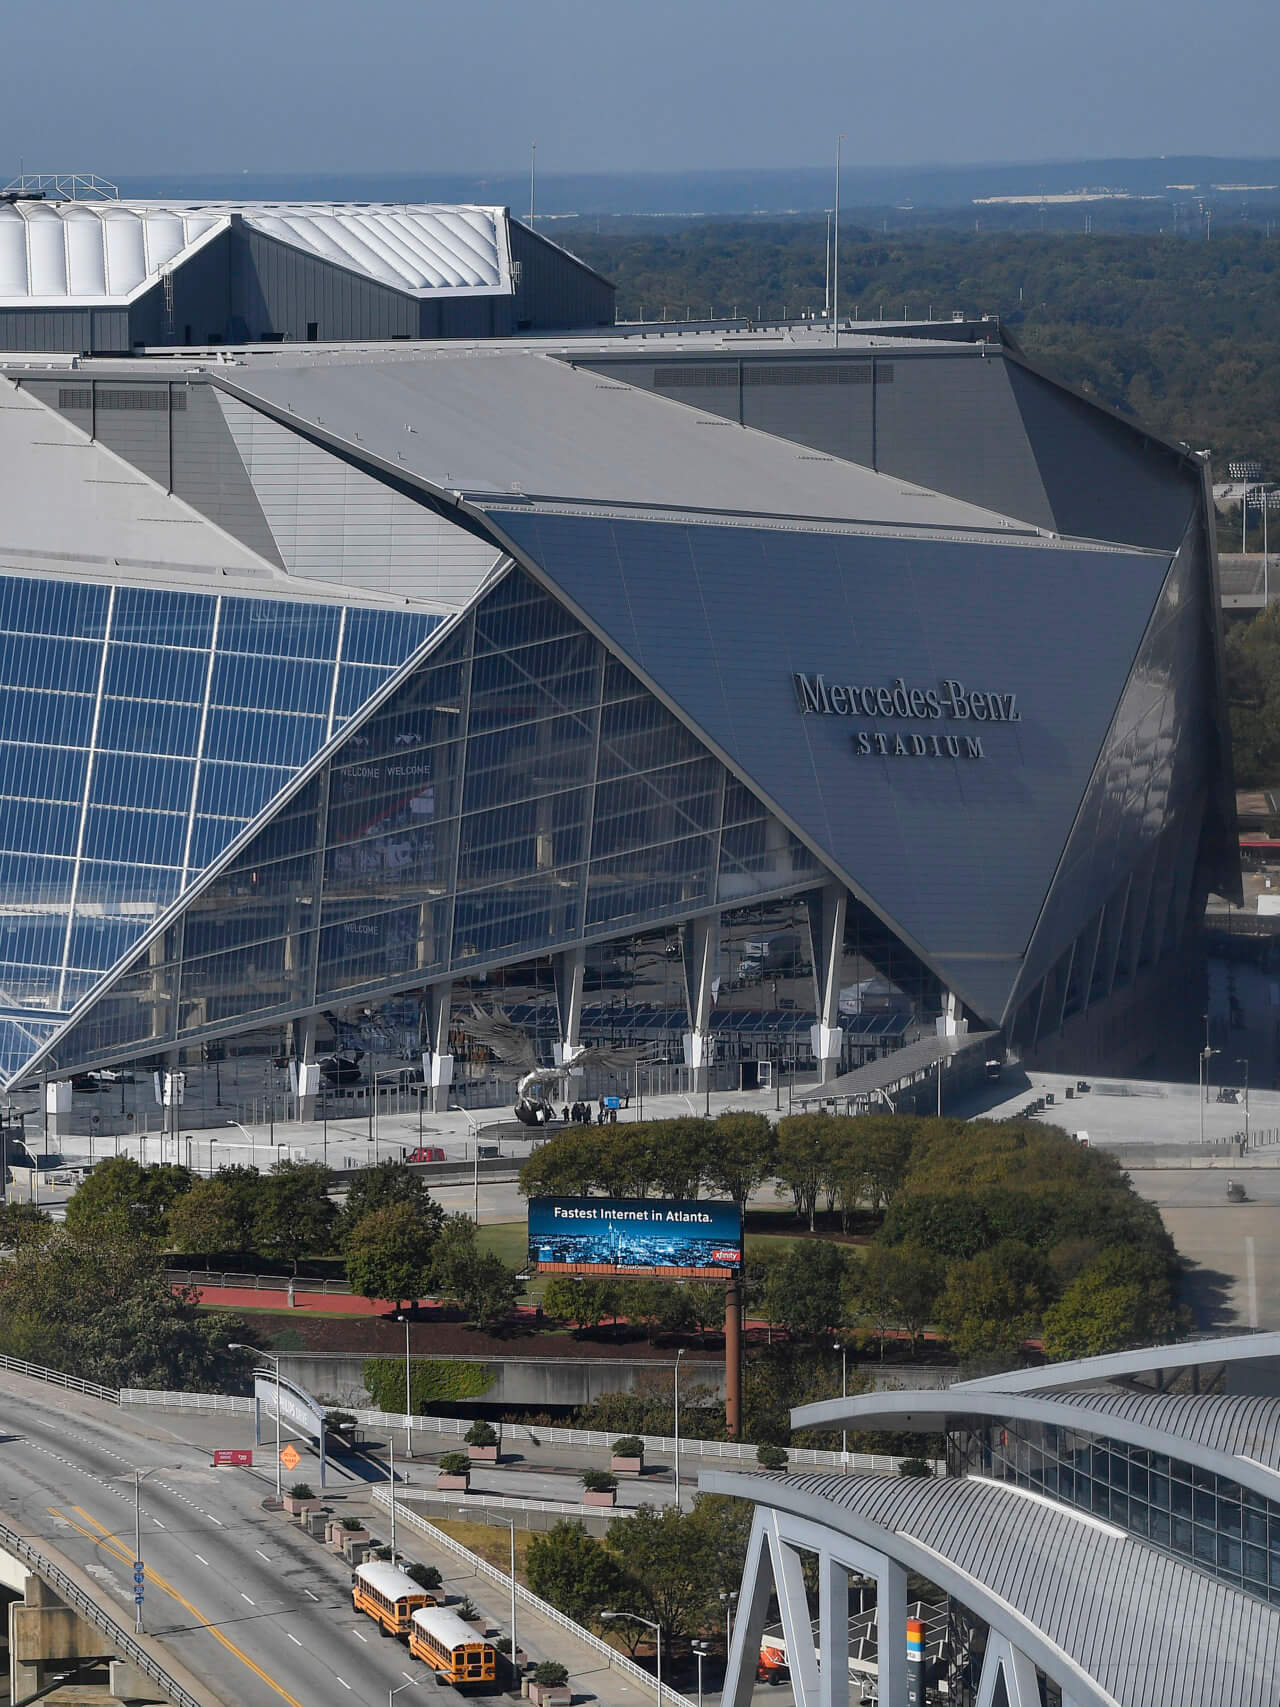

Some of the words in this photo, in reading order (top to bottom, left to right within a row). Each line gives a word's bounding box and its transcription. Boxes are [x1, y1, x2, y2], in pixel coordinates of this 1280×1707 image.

[794, 672, 1022, 721] Mercedes-Benz
[857, 731, 985, 759] STADIUM
[341, 767, 379, 778] WELCOME
[387, 765, 431, 776] WELCOME
[344, 922, 379, 935] WELCOME
[554, 1206, 598, 1220] Fastest
[600, 1208, 649, 1221] Internet
[651, 1209, 663, 1222] in
[666, 1210, 713, 1223] Atlanta.
[716, 1251, 737, 1261] xfinity
